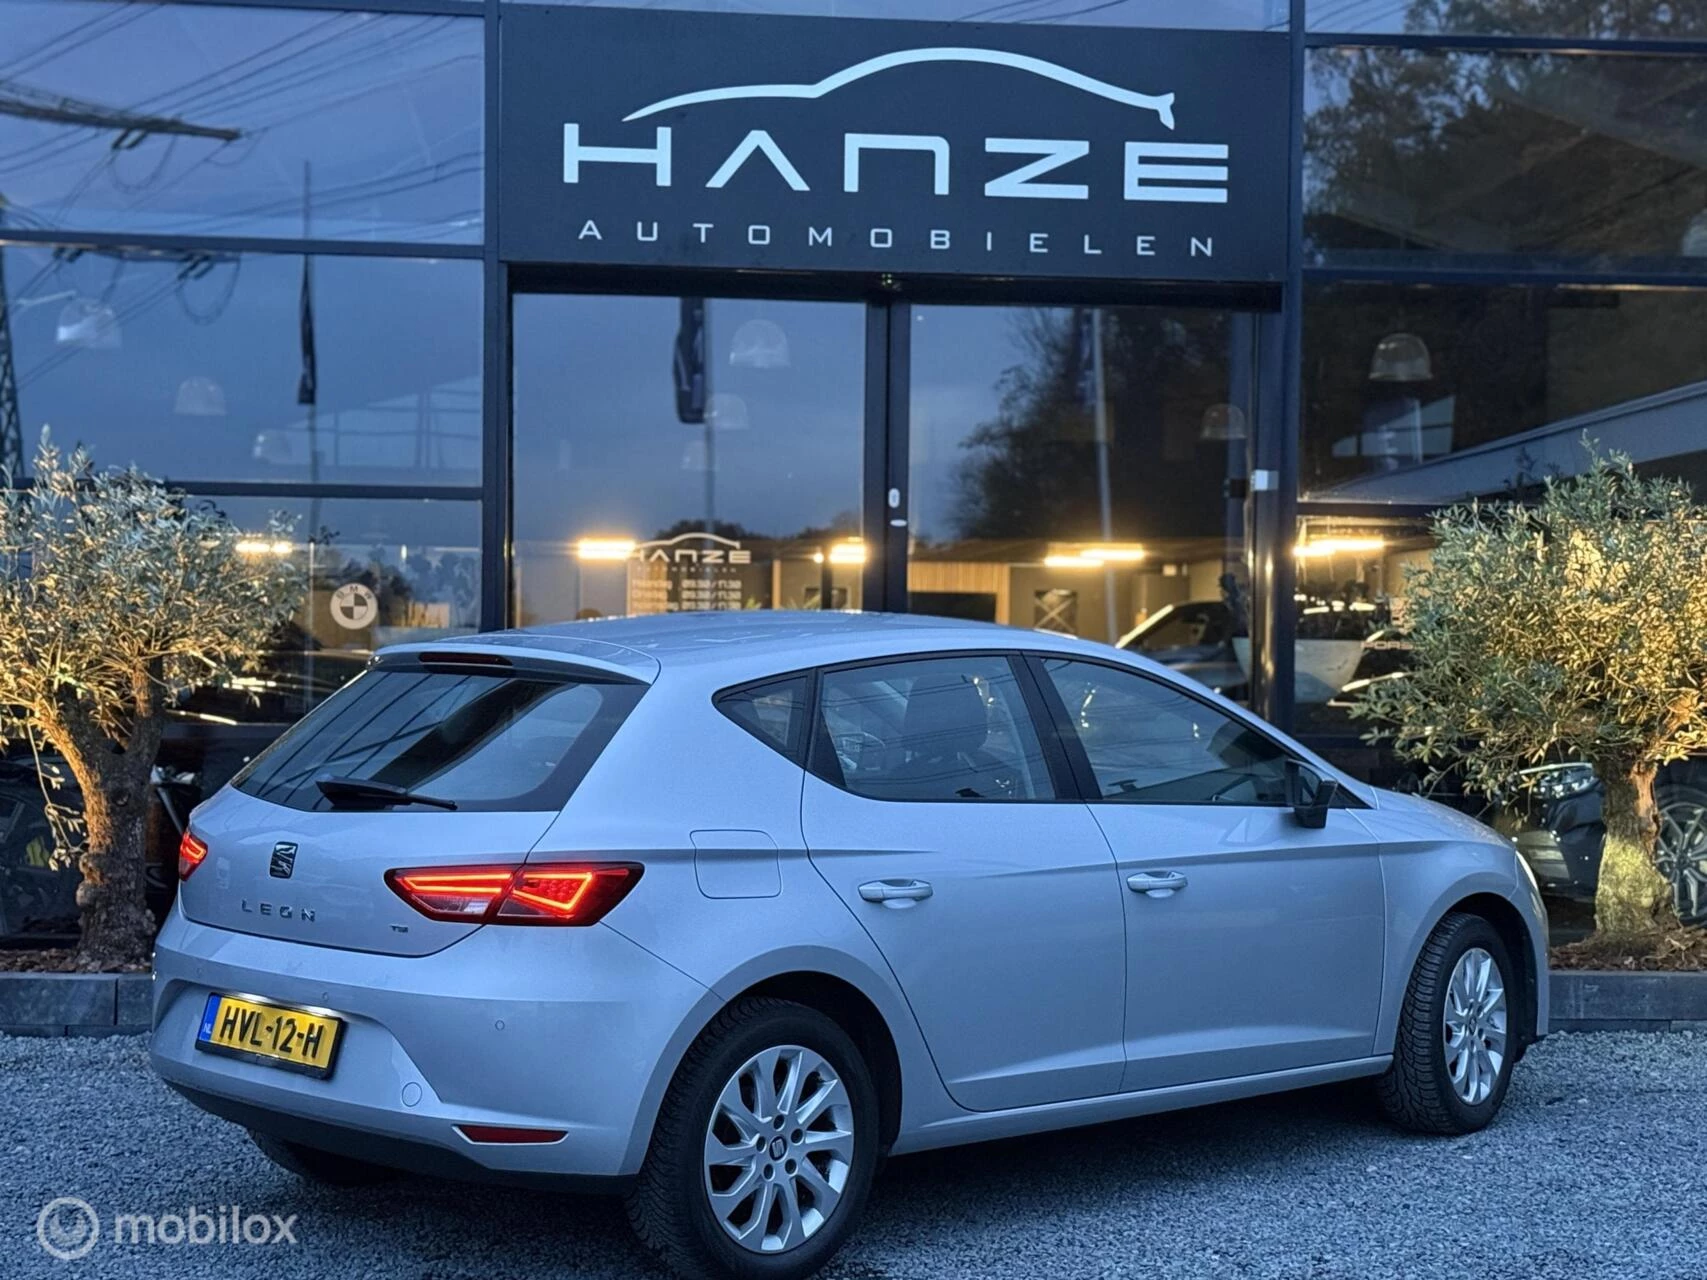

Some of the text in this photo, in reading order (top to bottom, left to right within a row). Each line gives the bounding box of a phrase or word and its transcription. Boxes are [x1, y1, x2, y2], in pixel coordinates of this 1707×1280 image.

[563, 123, 1229, 203] HANZE
[578, 220, 1213, 257] AUTOMOBIELEN
[241, 899, 316, 922] LEON
[202, 1022, 212, 1034] NL
[220, 1006, 324, 1058] HVL-12-H
